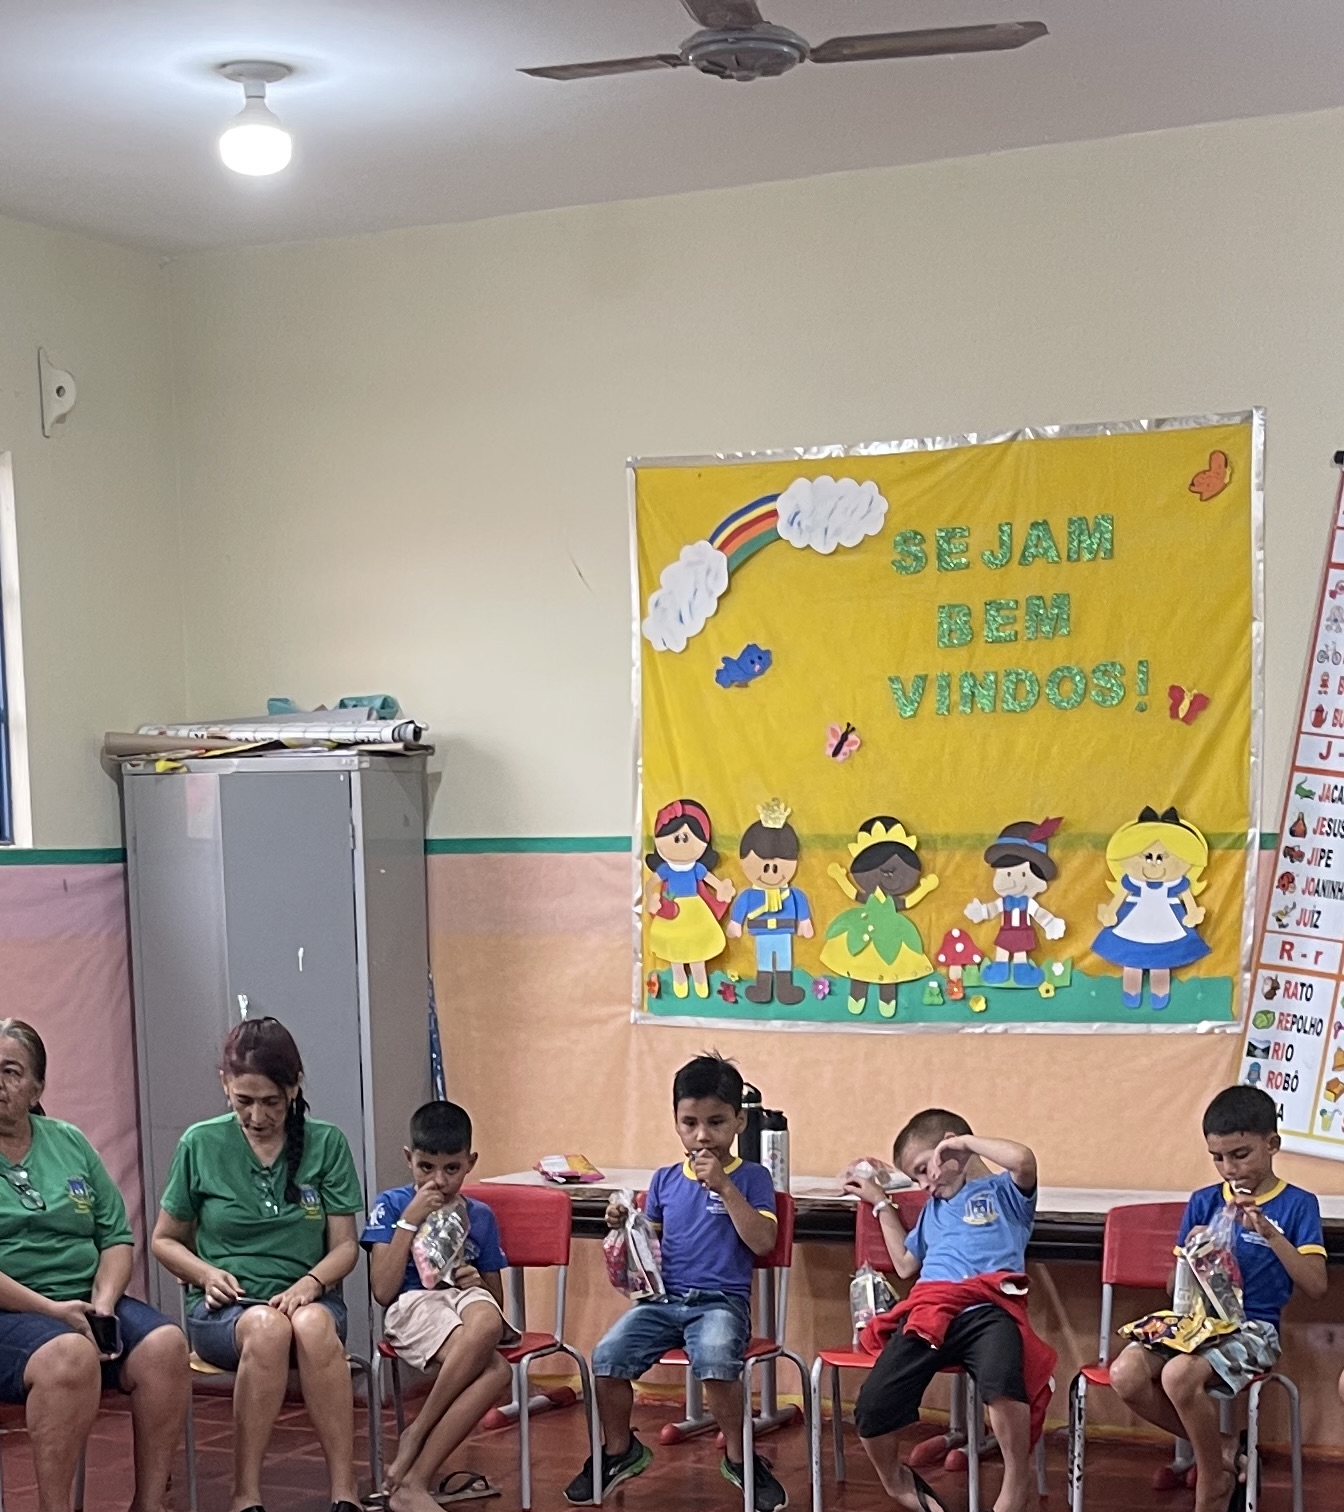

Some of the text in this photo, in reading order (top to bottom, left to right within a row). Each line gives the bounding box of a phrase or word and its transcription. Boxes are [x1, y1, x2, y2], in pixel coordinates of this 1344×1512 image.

[892, 513, 1114, 575] SEJAM
[936, 593, 1071, 648] BEM
[887, 661, 1149, 719] VINDOS!
[1318, 740, 1333, 760] J
[1307, 847, 1333, 868] JIPE
[1279, 941, 1295, 960] R
[1314, 950, 1323, 965] r
[1283, 980, 1314, 1002] RATO
[1277, 1011, 1323, 1037] REPOLHO
[1270, 1042, 1294, 1062] RIO
